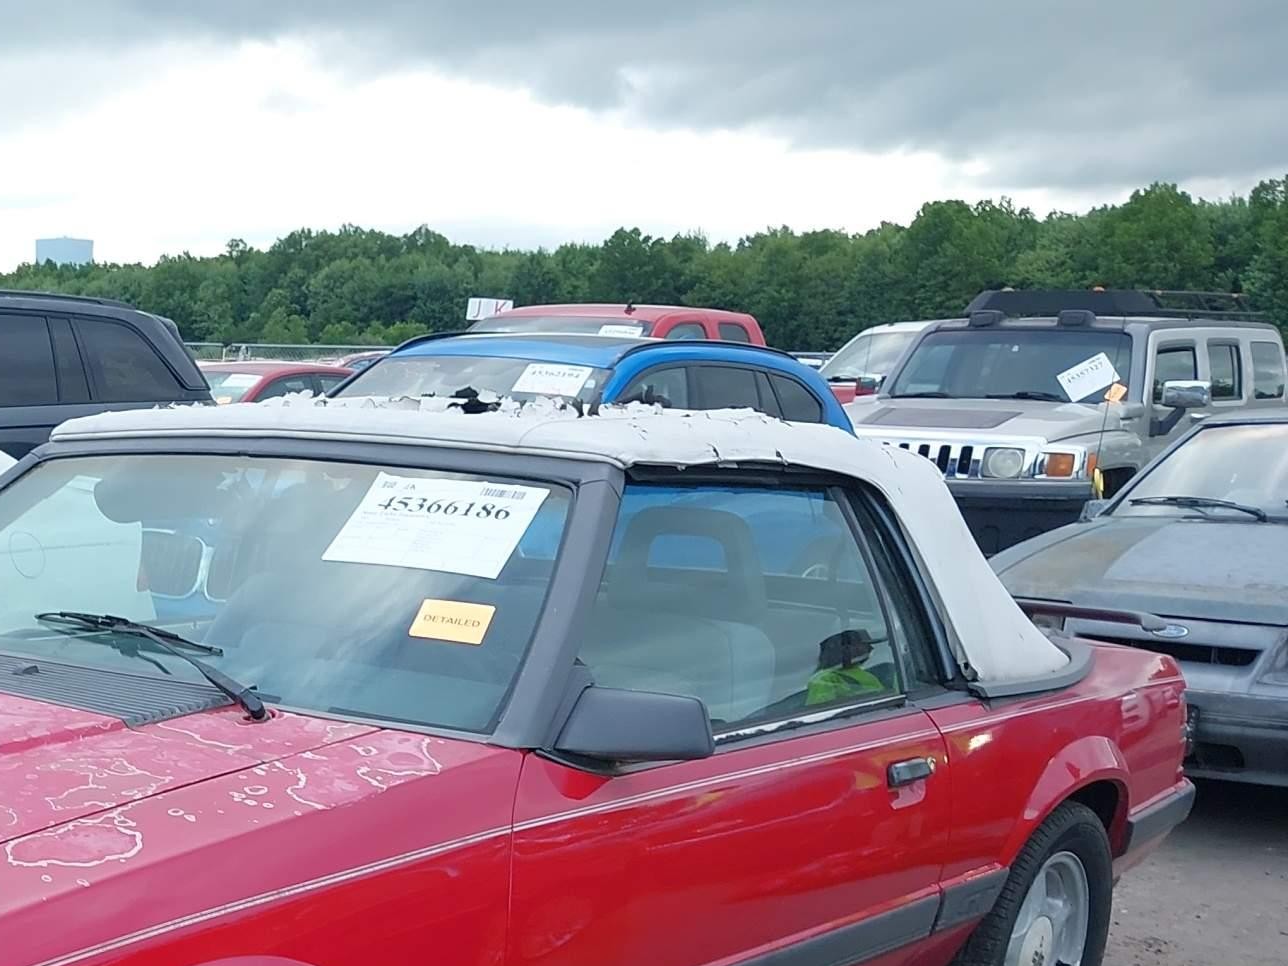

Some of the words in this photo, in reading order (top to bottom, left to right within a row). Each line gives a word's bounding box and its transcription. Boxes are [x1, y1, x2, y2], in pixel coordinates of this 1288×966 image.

[472, 300, 482, 318] J
[494, 300, 508, 313] K
[377, 496, 511, 521] 45366186
[423, 614, 481, 628] DETAILED
